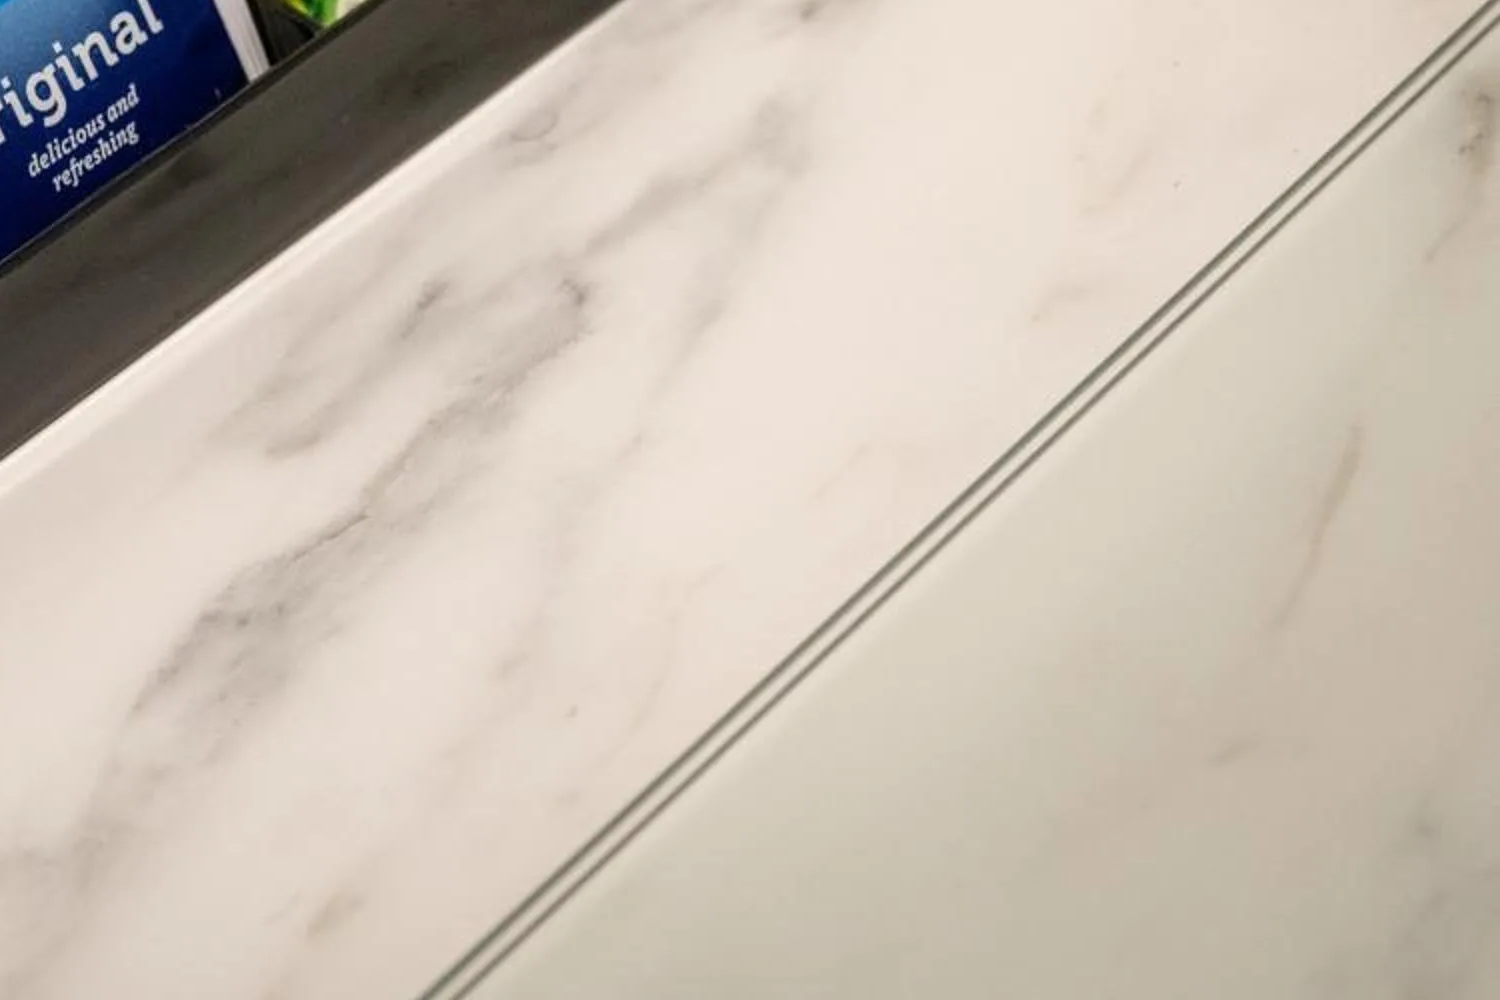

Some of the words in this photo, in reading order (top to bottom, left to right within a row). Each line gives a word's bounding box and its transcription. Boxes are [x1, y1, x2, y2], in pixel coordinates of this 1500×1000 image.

[27, 113, 106, 178] delicious
[106, 82, 141, 125] and
[51, 119, 140, 193] refreshing
